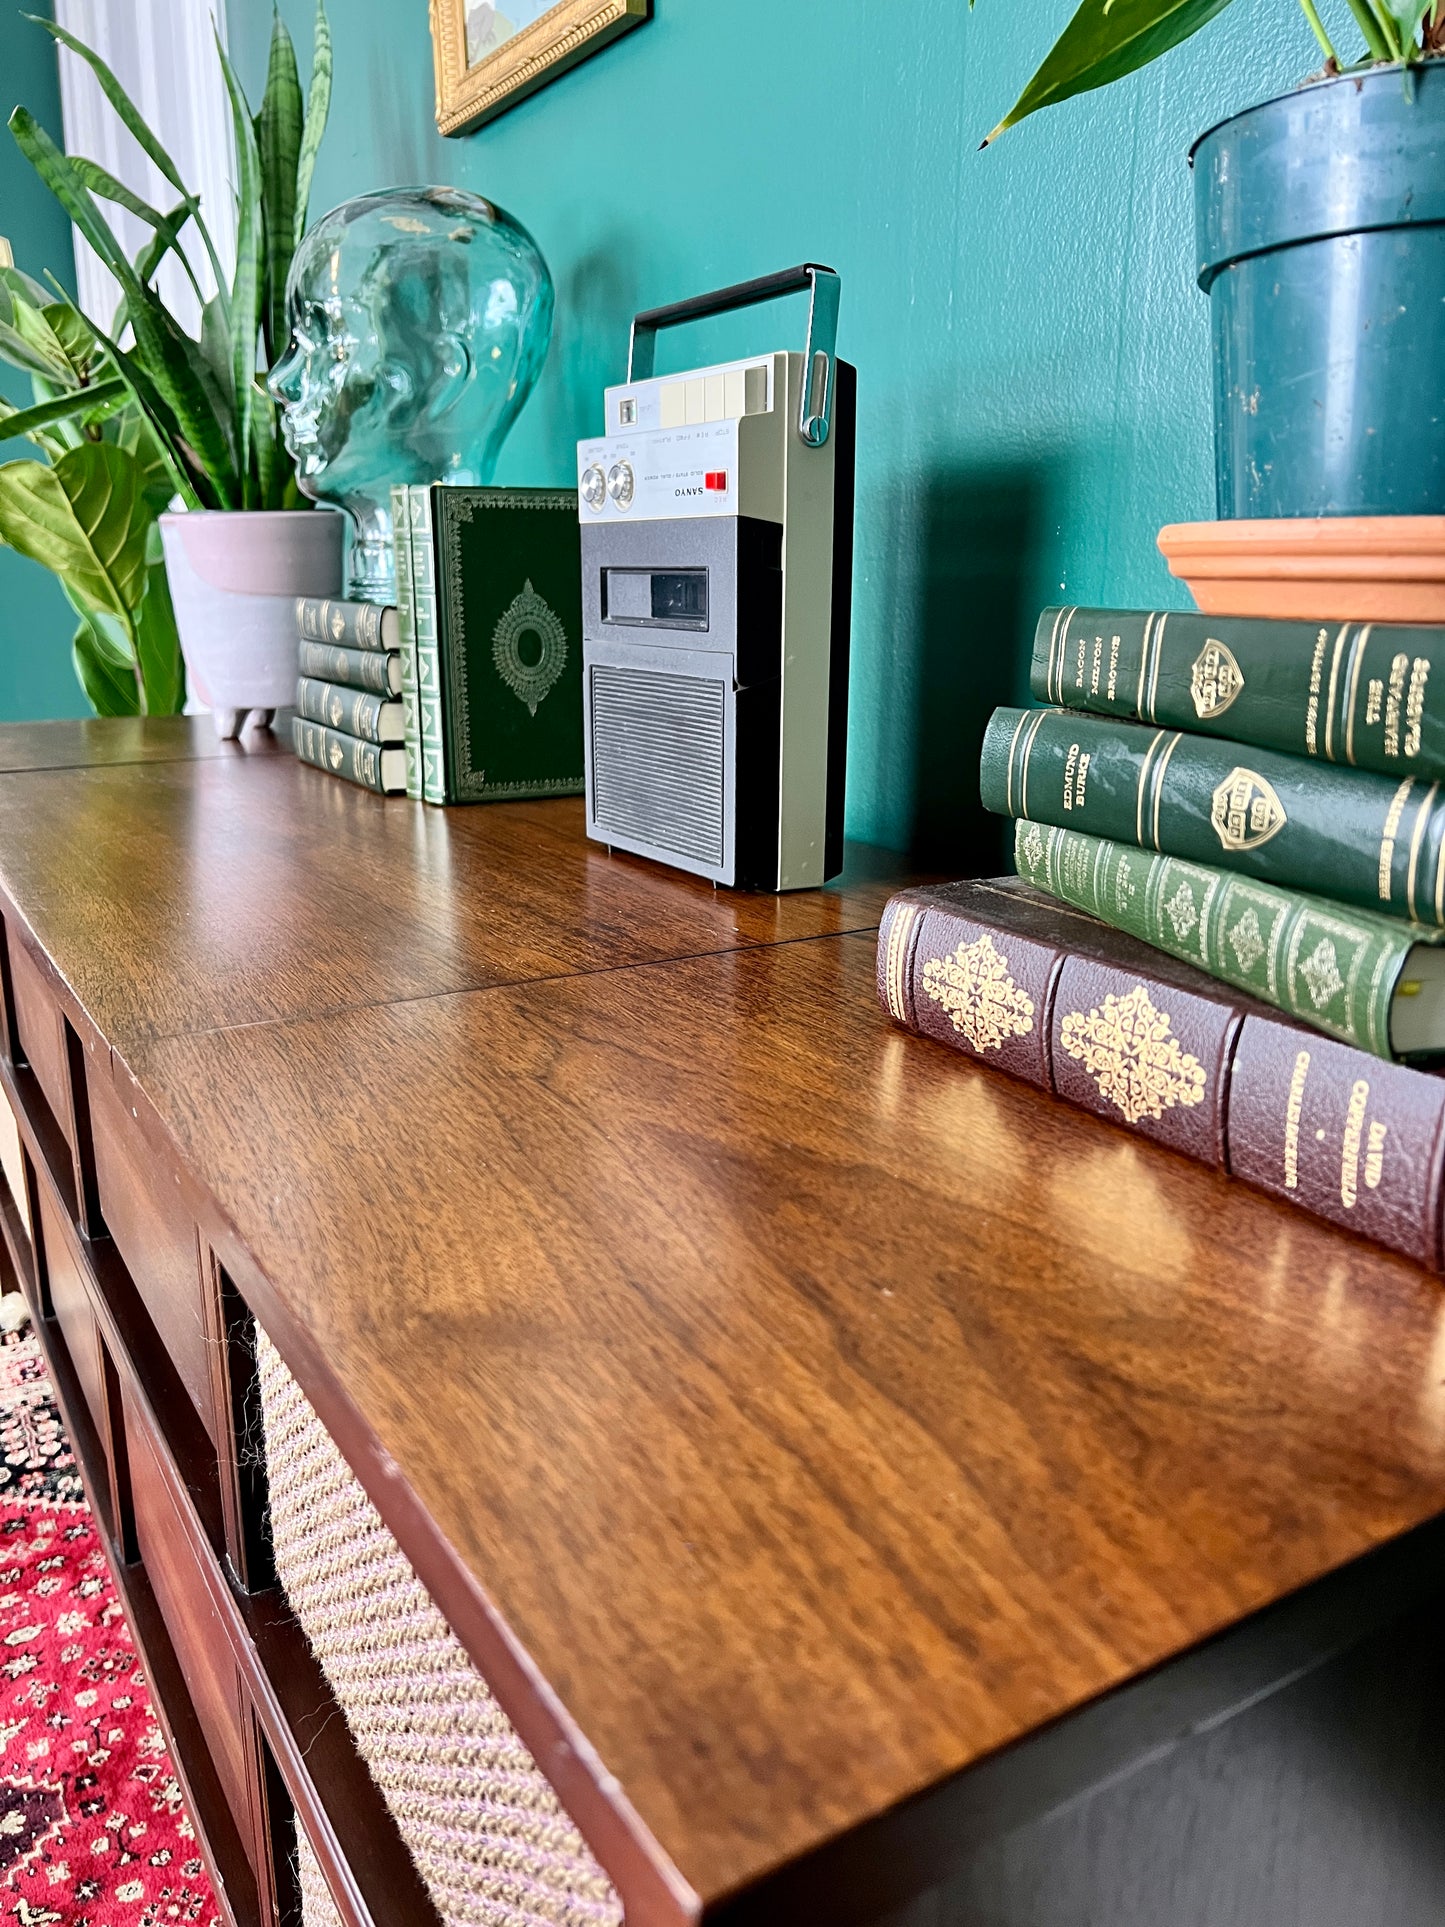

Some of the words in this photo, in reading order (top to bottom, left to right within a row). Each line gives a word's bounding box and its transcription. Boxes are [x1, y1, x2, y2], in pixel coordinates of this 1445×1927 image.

[674, 487, 704, 497] SANYO
[1076, 639, 1086, 688] BACON
[1091, 636, 1103, 695] MILTON
[1107, 635, 1121, 701] BROWNE
[1063, 743, 1080, 811] EDMUND
[1075, 753, 1091, 807] BURKE
[1286, 1051, 1311, 1122] CHARLES
[1340, 1080, 1370, 1209] COPPERFIELD
[1364, 1121, 1387, 1189] DAVID
